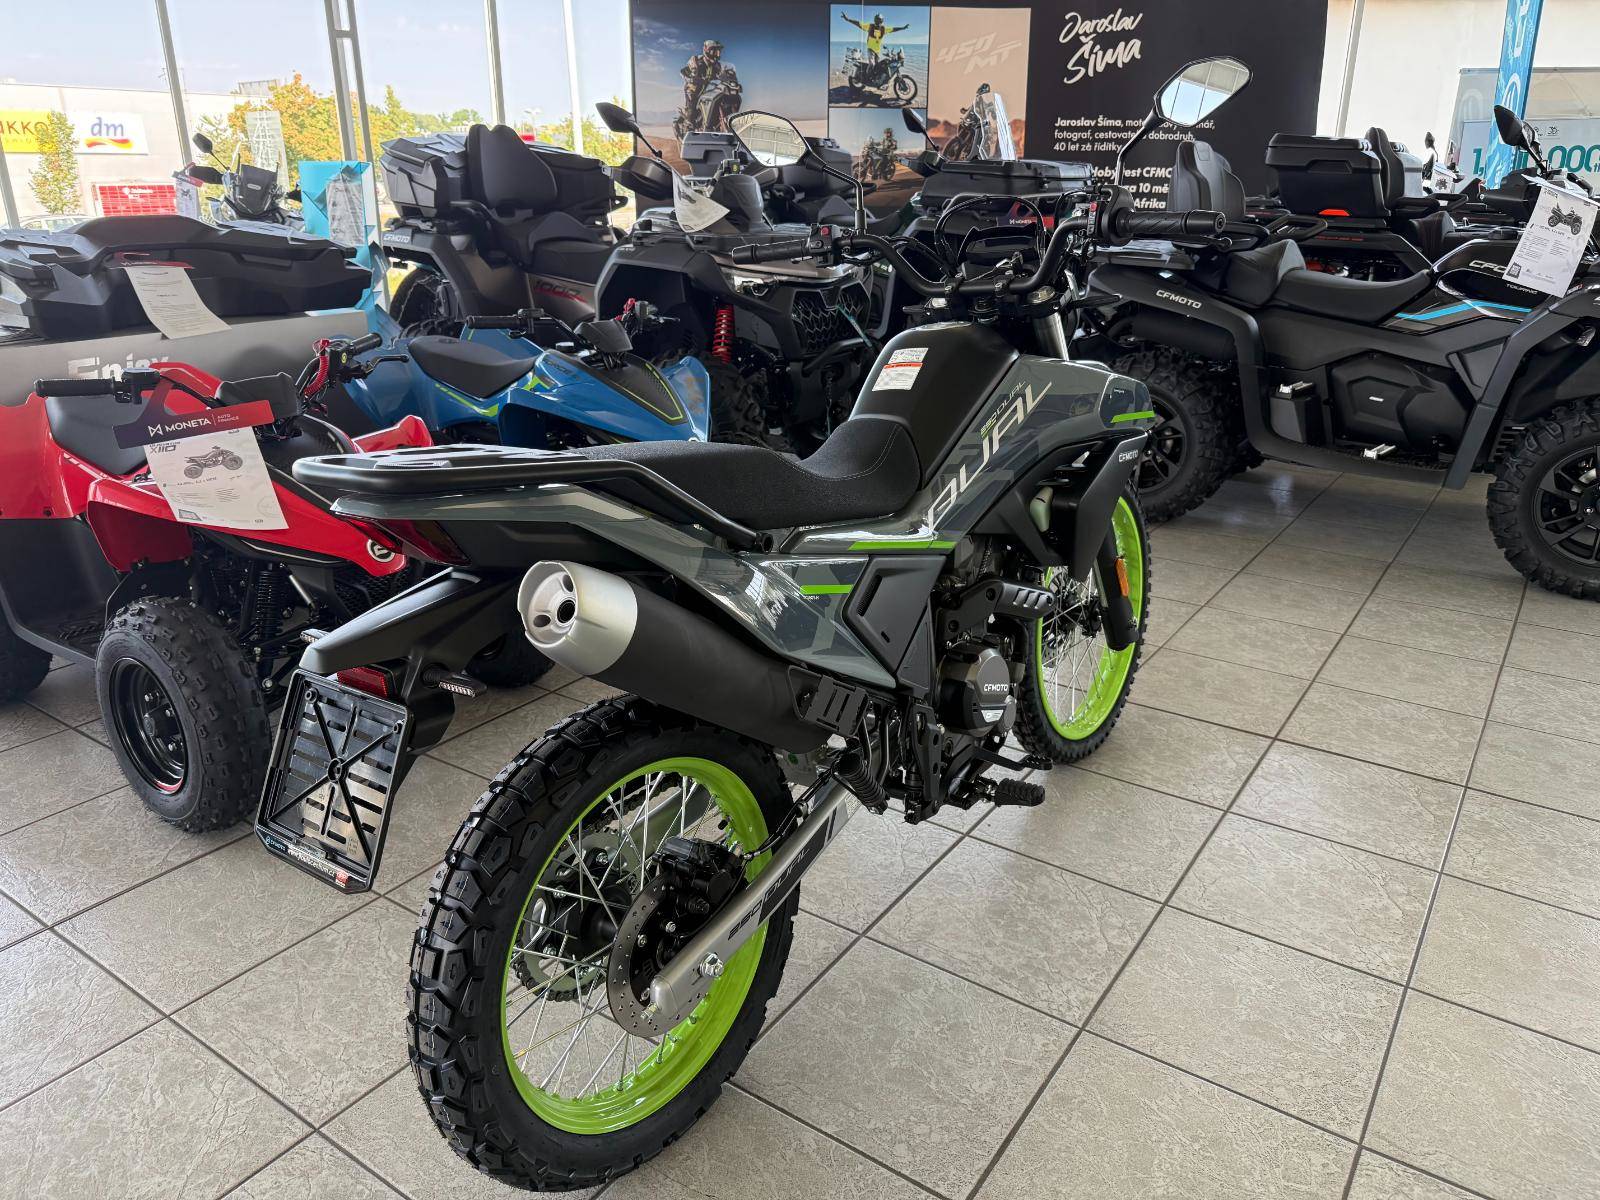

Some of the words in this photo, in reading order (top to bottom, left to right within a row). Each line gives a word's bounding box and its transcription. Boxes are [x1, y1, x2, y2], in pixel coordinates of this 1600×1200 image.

[1058, 8, 1143, 43] Jaroslav
[1063, 33, 1142, 84] Šíma
[91, 117, 125, 137] dm
[1054, 116, 1096, 127] Jaroslav
[1097, 114, 1124, 128] Šíma,
[1054, 129, 1092, 141] fotograf,
[1148, 130, 1196, 142] dobrodruh,
[1053, 142, 1066, 151] 40
[1067, 142, 1080, 151] let
[1139, 182, 1151, 193] 10
[1133, 198, 1166, 209] Afrika
[382, 233, 411, 243] CFMOTO
[1155, 289, 1202, 309] CFMOTO
[165, 418, 211, 432] MONETA
[927, 381, 1052, 532] DUAL
[1118, 449, 1138, 462] CFMOTO
[983, 683, 1009, 692] CFMOTO
